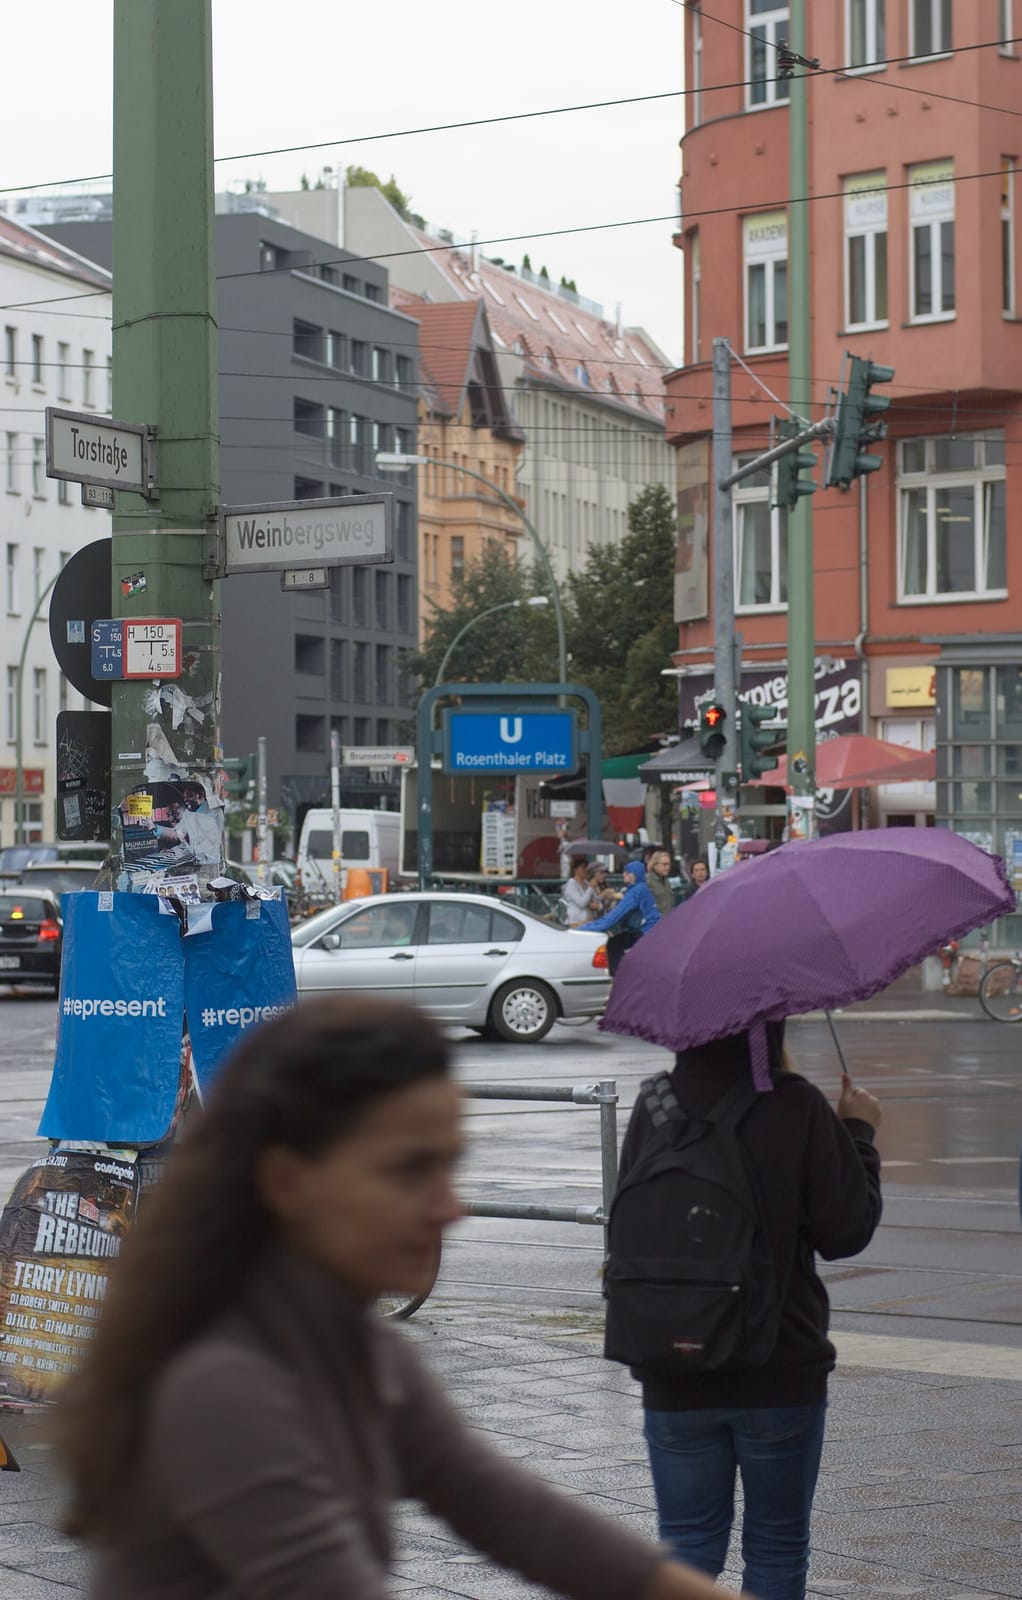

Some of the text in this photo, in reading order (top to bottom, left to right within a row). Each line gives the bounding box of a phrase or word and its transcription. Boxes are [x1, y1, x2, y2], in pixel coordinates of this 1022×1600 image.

[70, 427, 128, 475] Torstraße
[88, 489, 97, 500] 93
[236, 517, 375, 550] Weinbergsweg
[93, 630, 122, 642] S 150
[127, 626, 164, 640] H 150
[102, 663, 114, 673] 6.0
[499, 717, 523, 744] U
[456, 751, 567, 766] Rosenthaler Platz
[63, 996, 166, 1021] #represent
[46, 1191, 80, 1220] THE
[34, 1213, 121, 1258] REBELUTION
[13, 1261, 108, 1301] TERRY LYNN
[19, 1295, 47, 1310] ROBERT
[47, 1299, 70, 1314] SMITH
[6, 1312, 17, 1327] DJ
[44, 1319, 55, 1334] DJ
